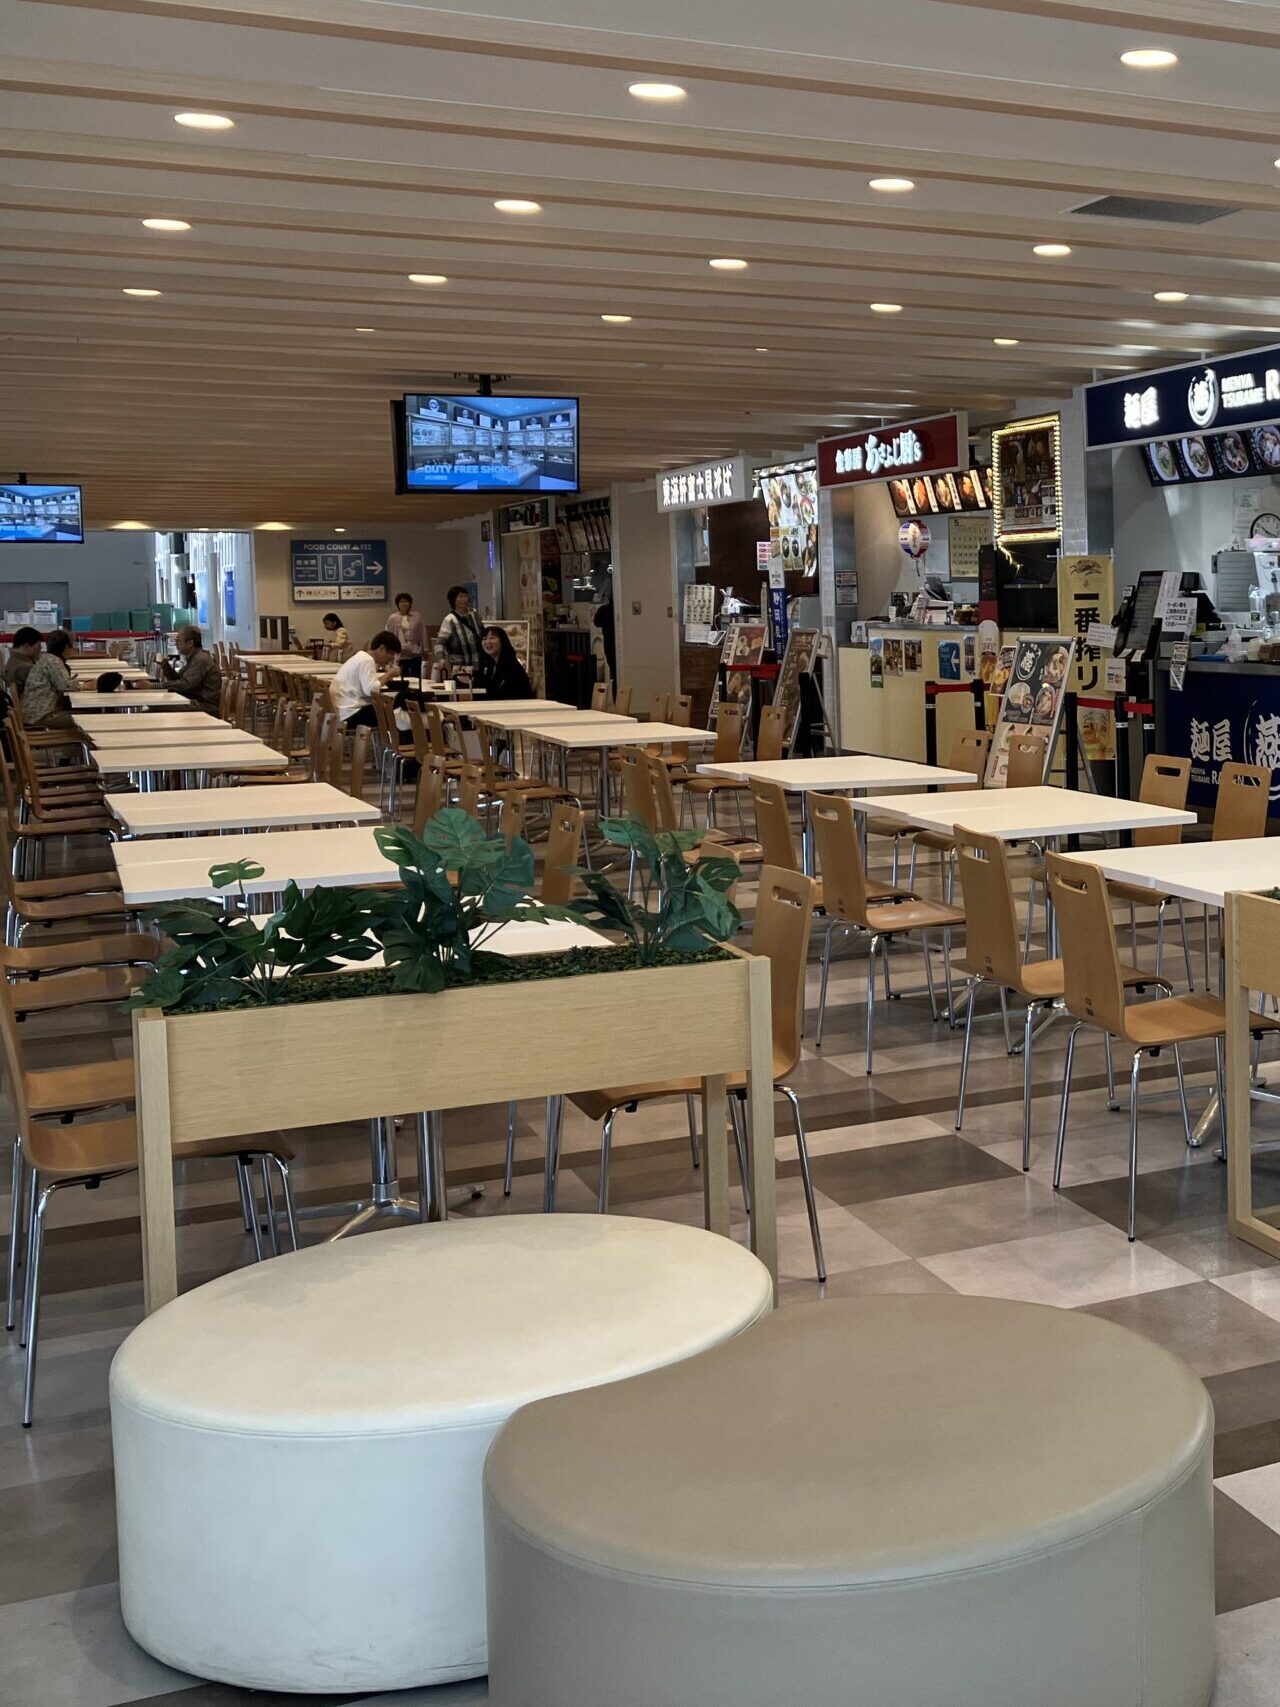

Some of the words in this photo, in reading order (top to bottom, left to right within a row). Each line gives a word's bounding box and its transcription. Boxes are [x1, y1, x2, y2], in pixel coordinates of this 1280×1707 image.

[424, 463, 453, 474] DUTY
[454, 463, 479, 474] FREE
[1073, 593, 1101, 691] 一番搾り
